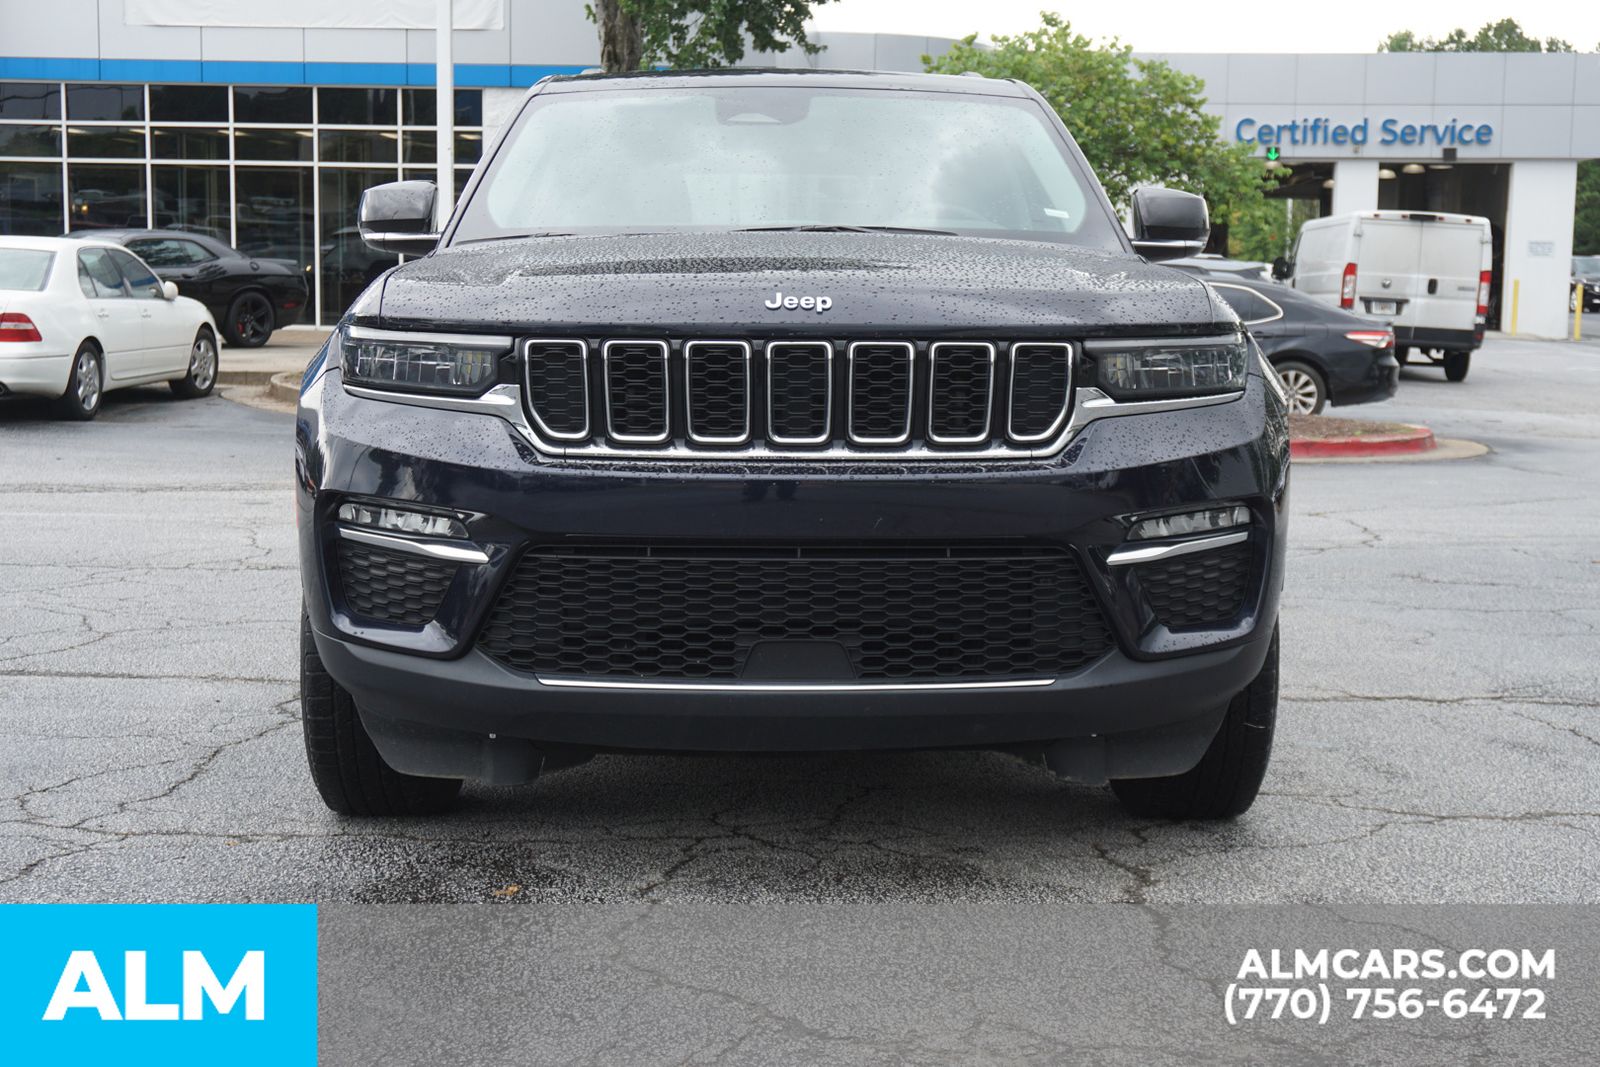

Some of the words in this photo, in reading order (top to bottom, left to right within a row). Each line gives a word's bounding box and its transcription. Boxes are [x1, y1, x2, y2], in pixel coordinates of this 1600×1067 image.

[1236, 118, 1369, 145] Certified
[1380, 118, 1493, 146] Service
[765, 292, 833, 313] Jeep
